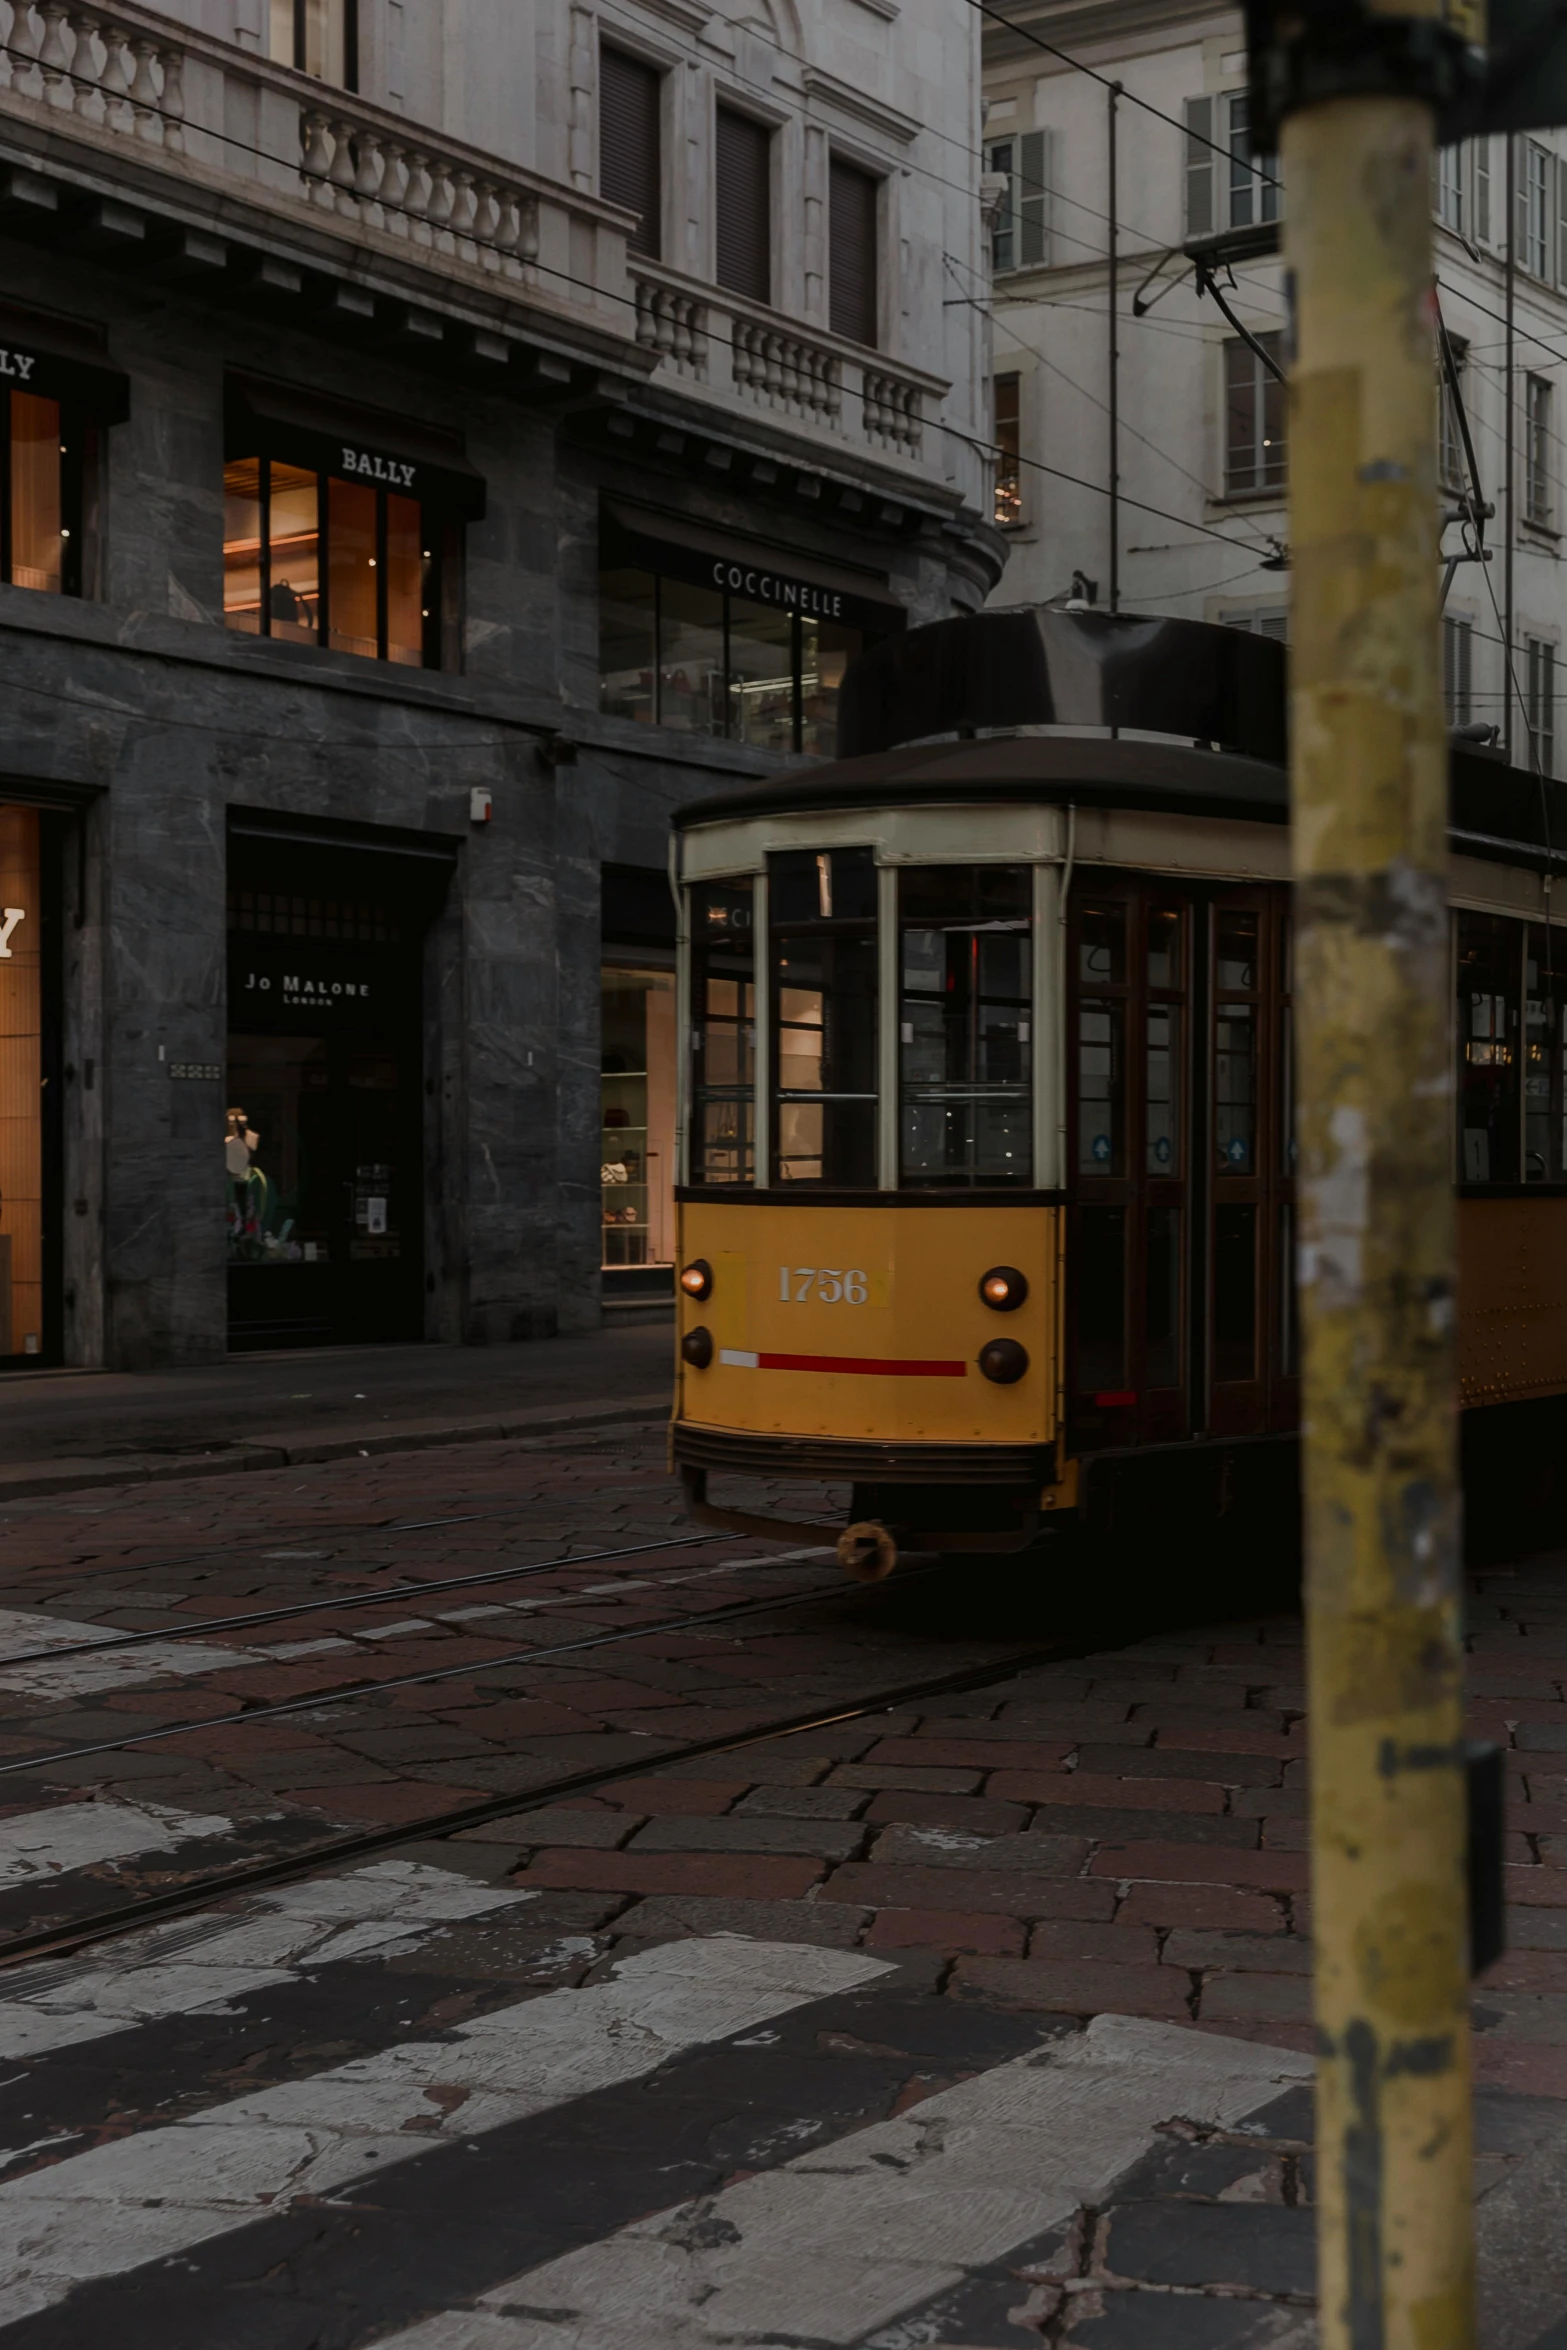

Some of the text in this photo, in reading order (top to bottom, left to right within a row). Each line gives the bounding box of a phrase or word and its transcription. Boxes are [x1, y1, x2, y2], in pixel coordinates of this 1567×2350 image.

[341, 447, 416, 487] BALLY
[712, 562, 842, 617] COCCINELLE
[282, 975, 370, 997] MALONE
[778, 1266, 869, 1304] 1756
